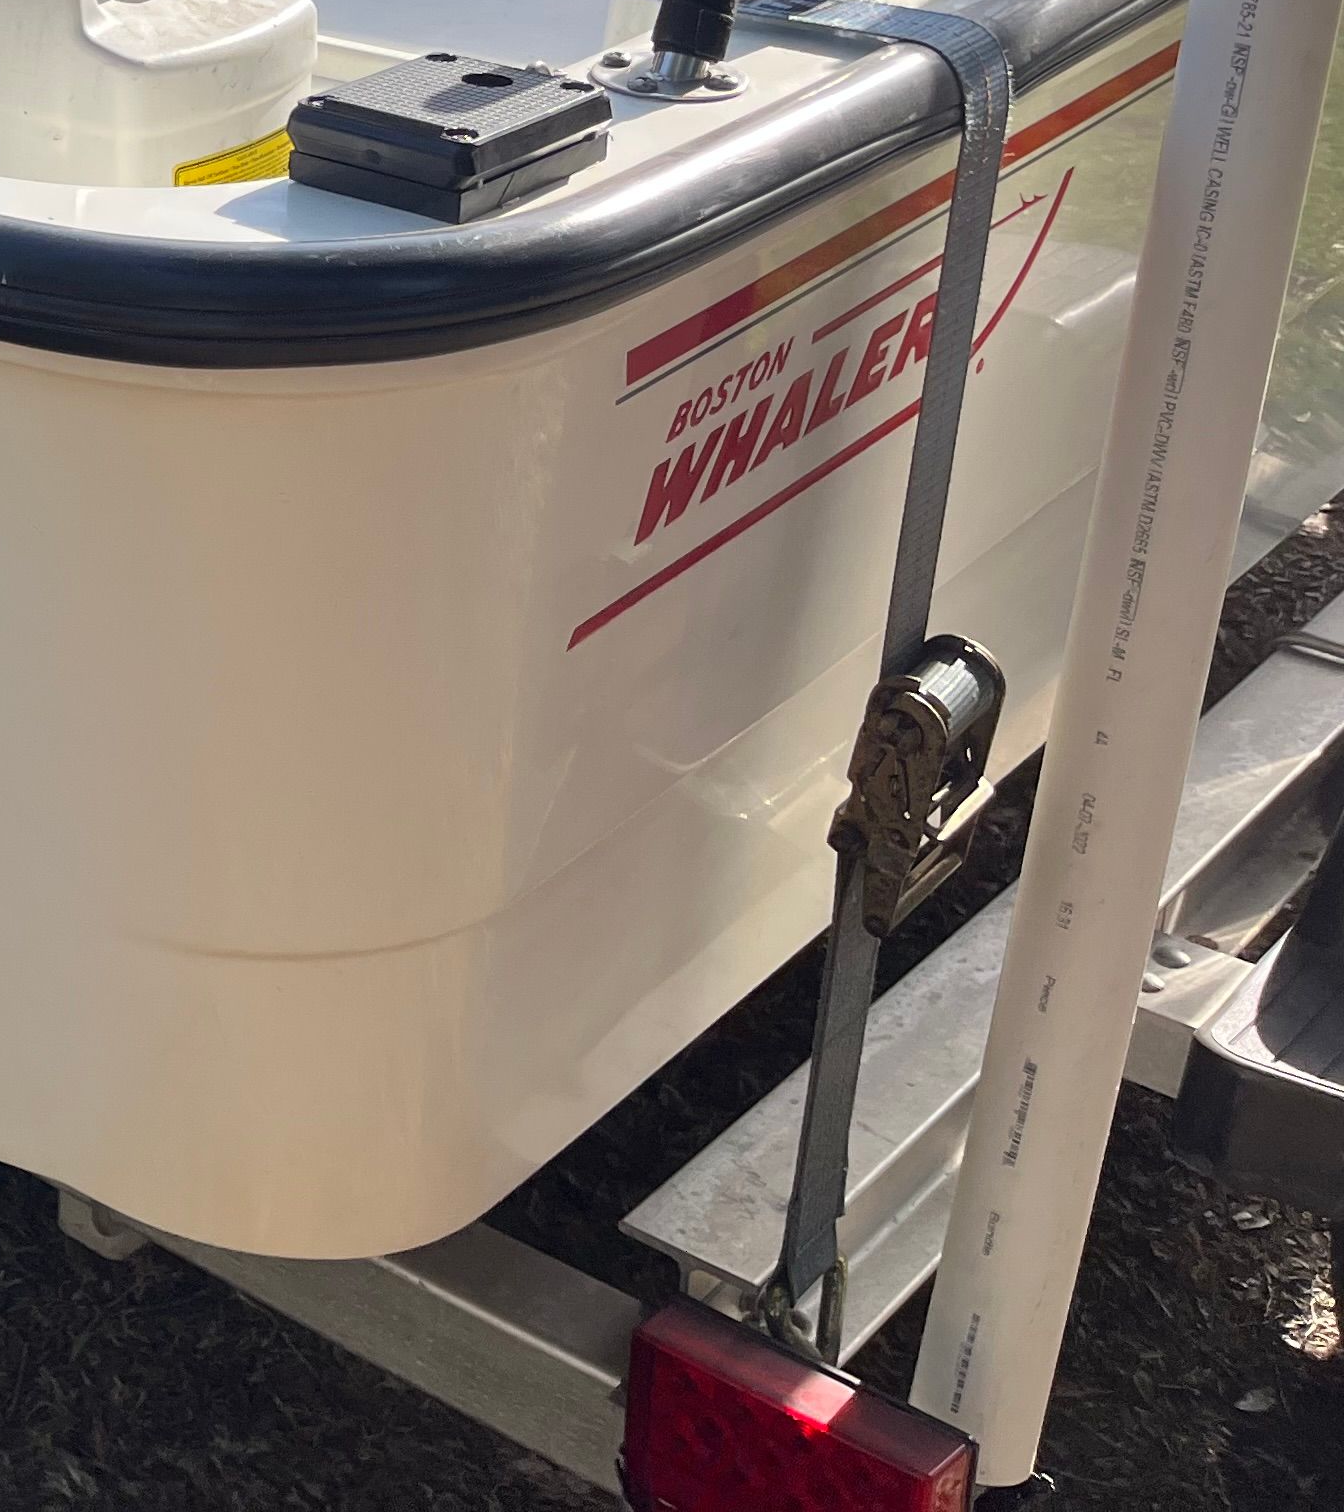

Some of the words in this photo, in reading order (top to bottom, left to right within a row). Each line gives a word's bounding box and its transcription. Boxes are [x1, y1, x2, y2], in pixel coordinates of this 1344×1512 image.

[1211, 127, 1233, 162] WELL
[1199, 168, 1223, 223] CASING
[665, 335, 795, 444] BOSTON
